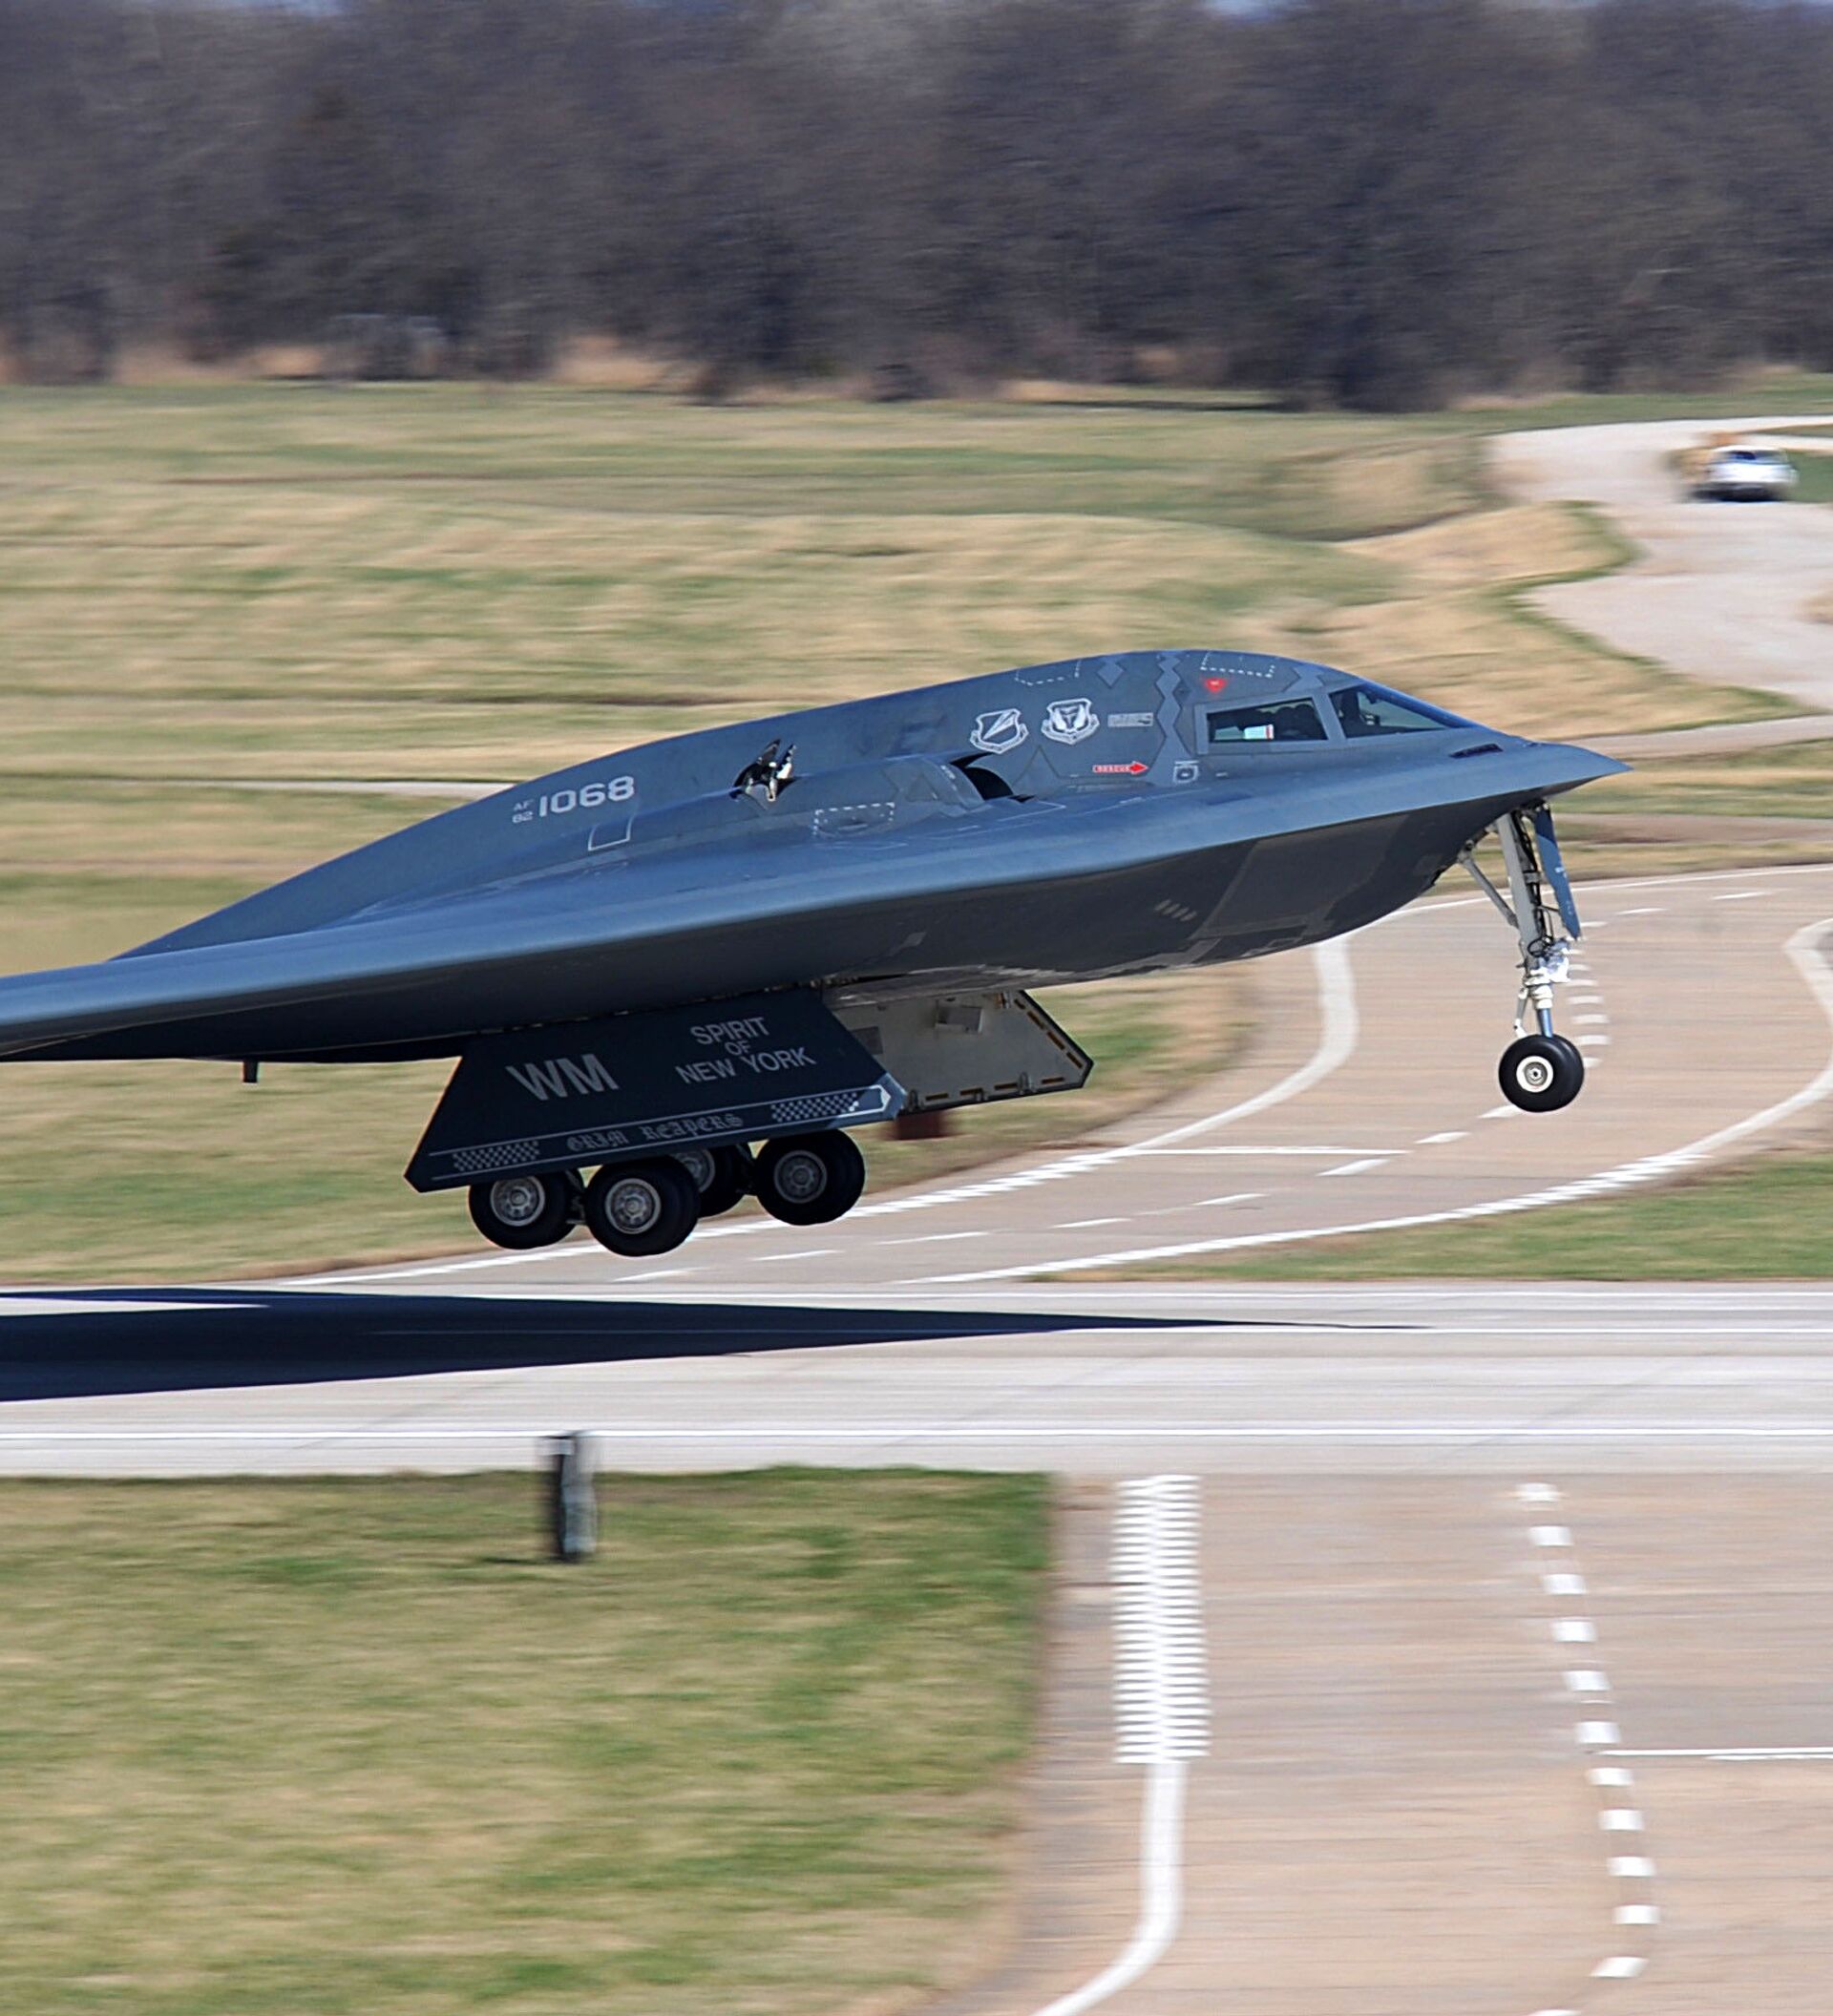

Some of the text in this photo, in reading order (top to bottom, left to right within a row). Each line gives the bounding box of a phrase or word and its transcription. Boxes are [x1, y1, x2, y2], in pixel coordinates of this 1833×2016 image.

[539, 776, 635, 816] 1068
[689, 1016, 769, 1045] SPIRIT
[724, 1040, 751, 1057] OF
[505, 1054, 620, 1102] WM
[675, 1046, 817, 1085] NEW YORK
[567, 1114, 744, 1151] GRIM REAPERS
